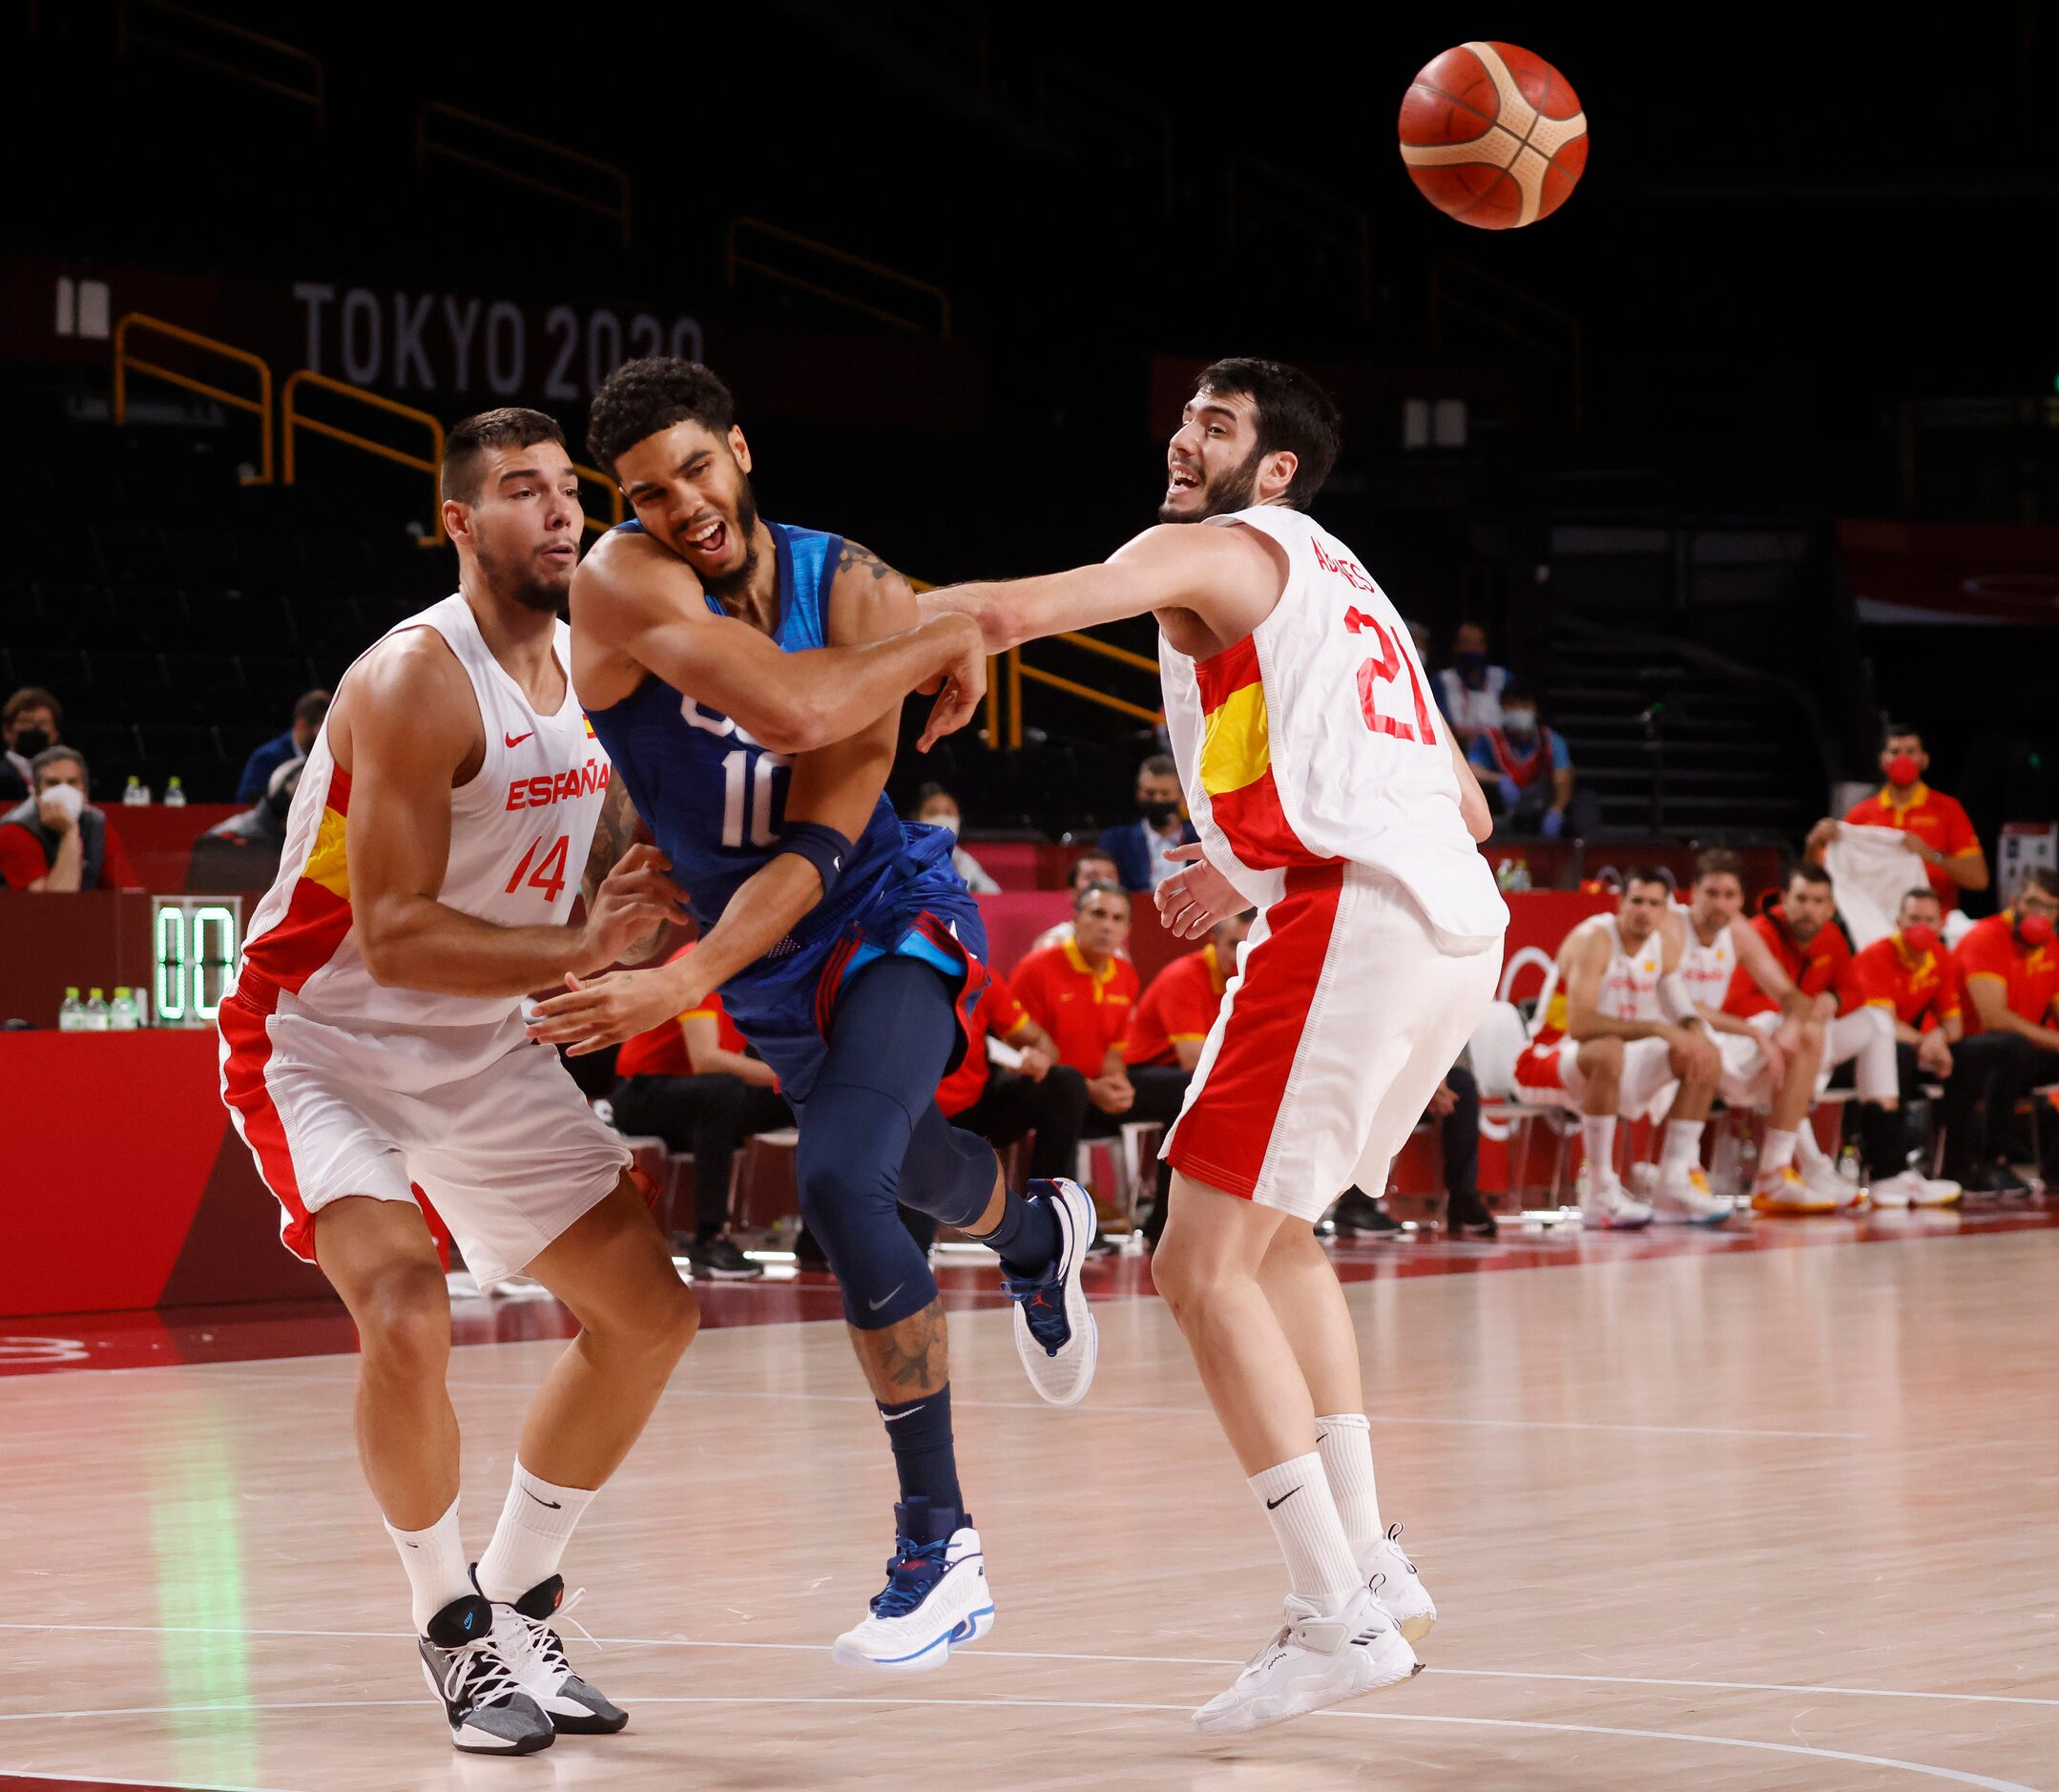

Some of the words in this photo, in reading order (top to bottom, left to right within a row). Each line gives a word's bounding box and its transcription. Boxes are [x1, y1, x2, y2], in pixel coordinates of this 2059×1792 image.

[293, 281, 527, 395] TOKYO
[1343, 605, 1437, 746] 21
[505, 758, 611, 811] ESPAÑA
[505, 835, 570, 903] 14
